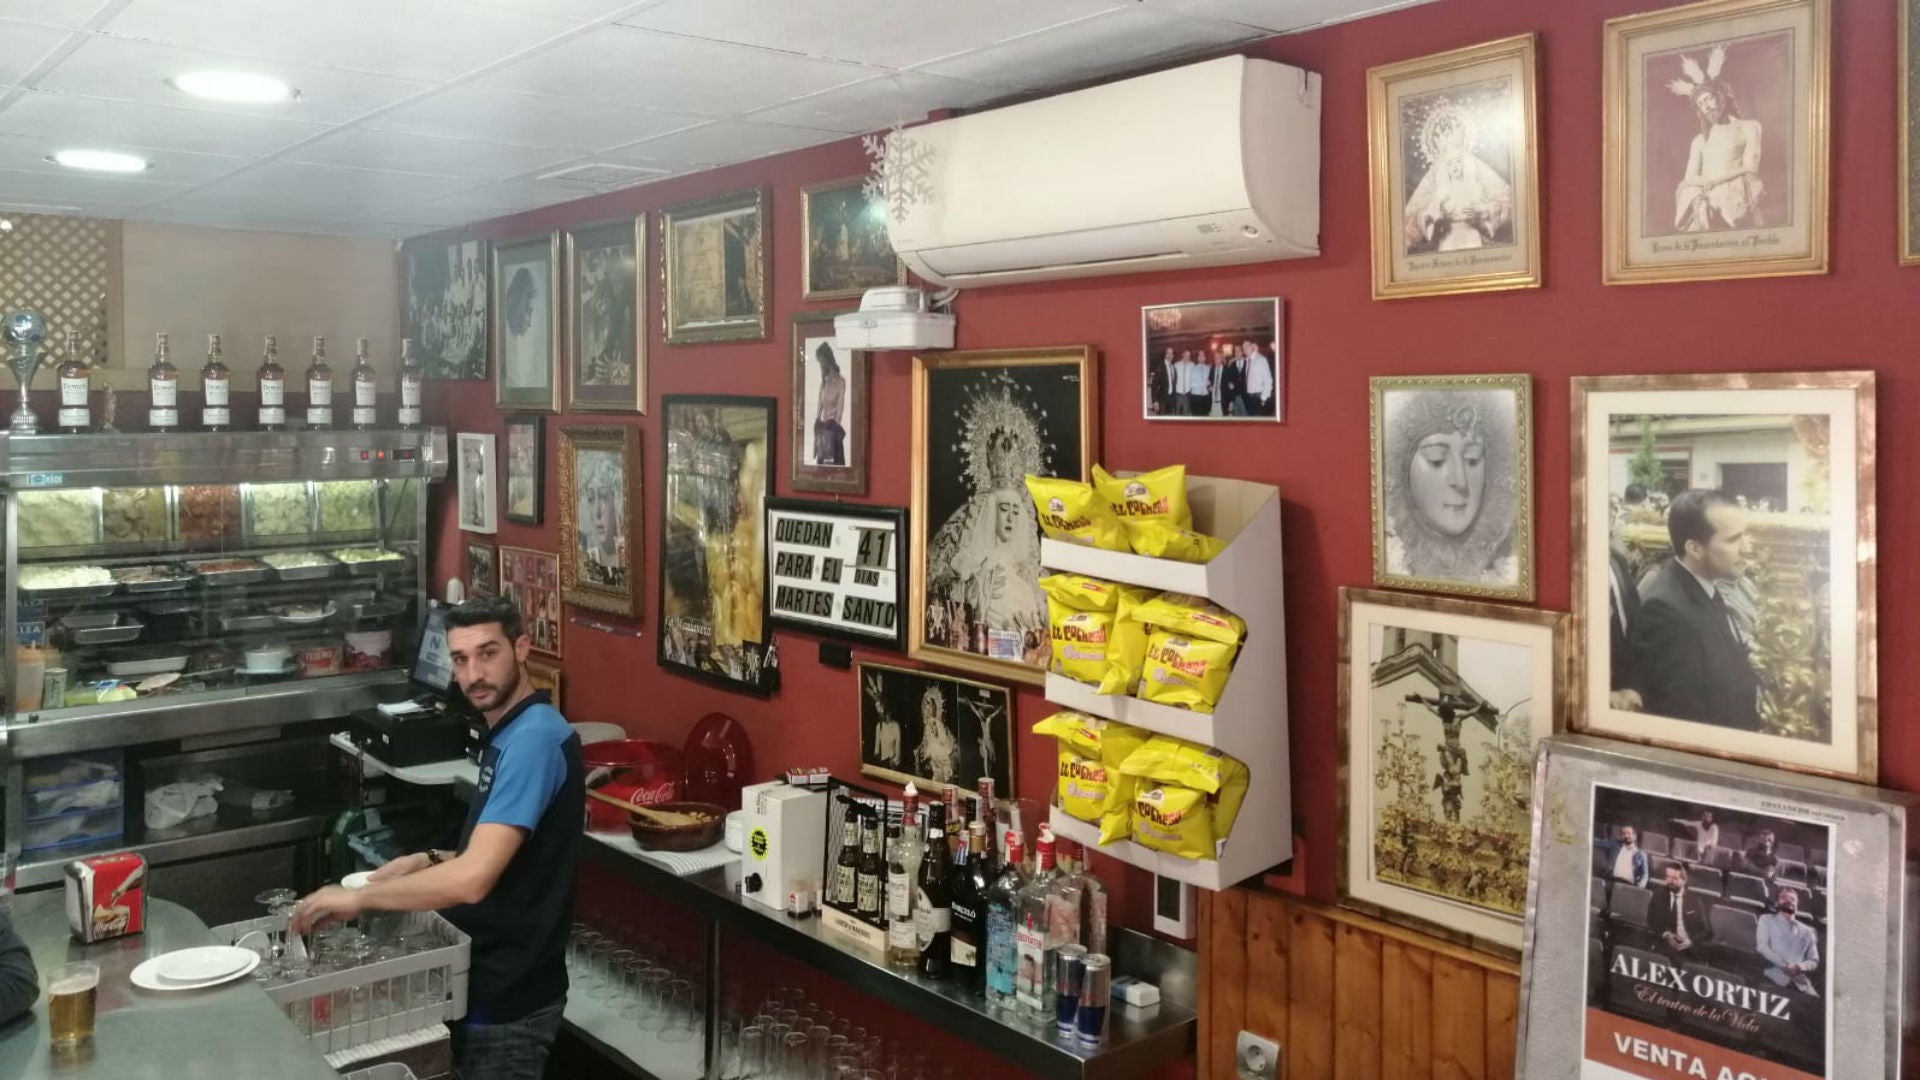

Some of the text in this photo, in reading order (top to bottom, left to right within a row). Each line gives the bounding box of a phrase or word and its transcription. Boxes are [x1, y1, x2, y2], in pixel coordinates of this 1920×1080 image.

[775, 518, 887, 568] QUEDAN 41
[775, 551, 815, 580] PARA
[821, 556, 843, 584] EL
[775, 585, 896, 630] MARTES SANTO
[1610, 953, 1792, 1021] ALEX ORTIZ
[1720, 1009, 1761, 1034] Vida
[1613, 1031, 1708, 1080] VENTA
